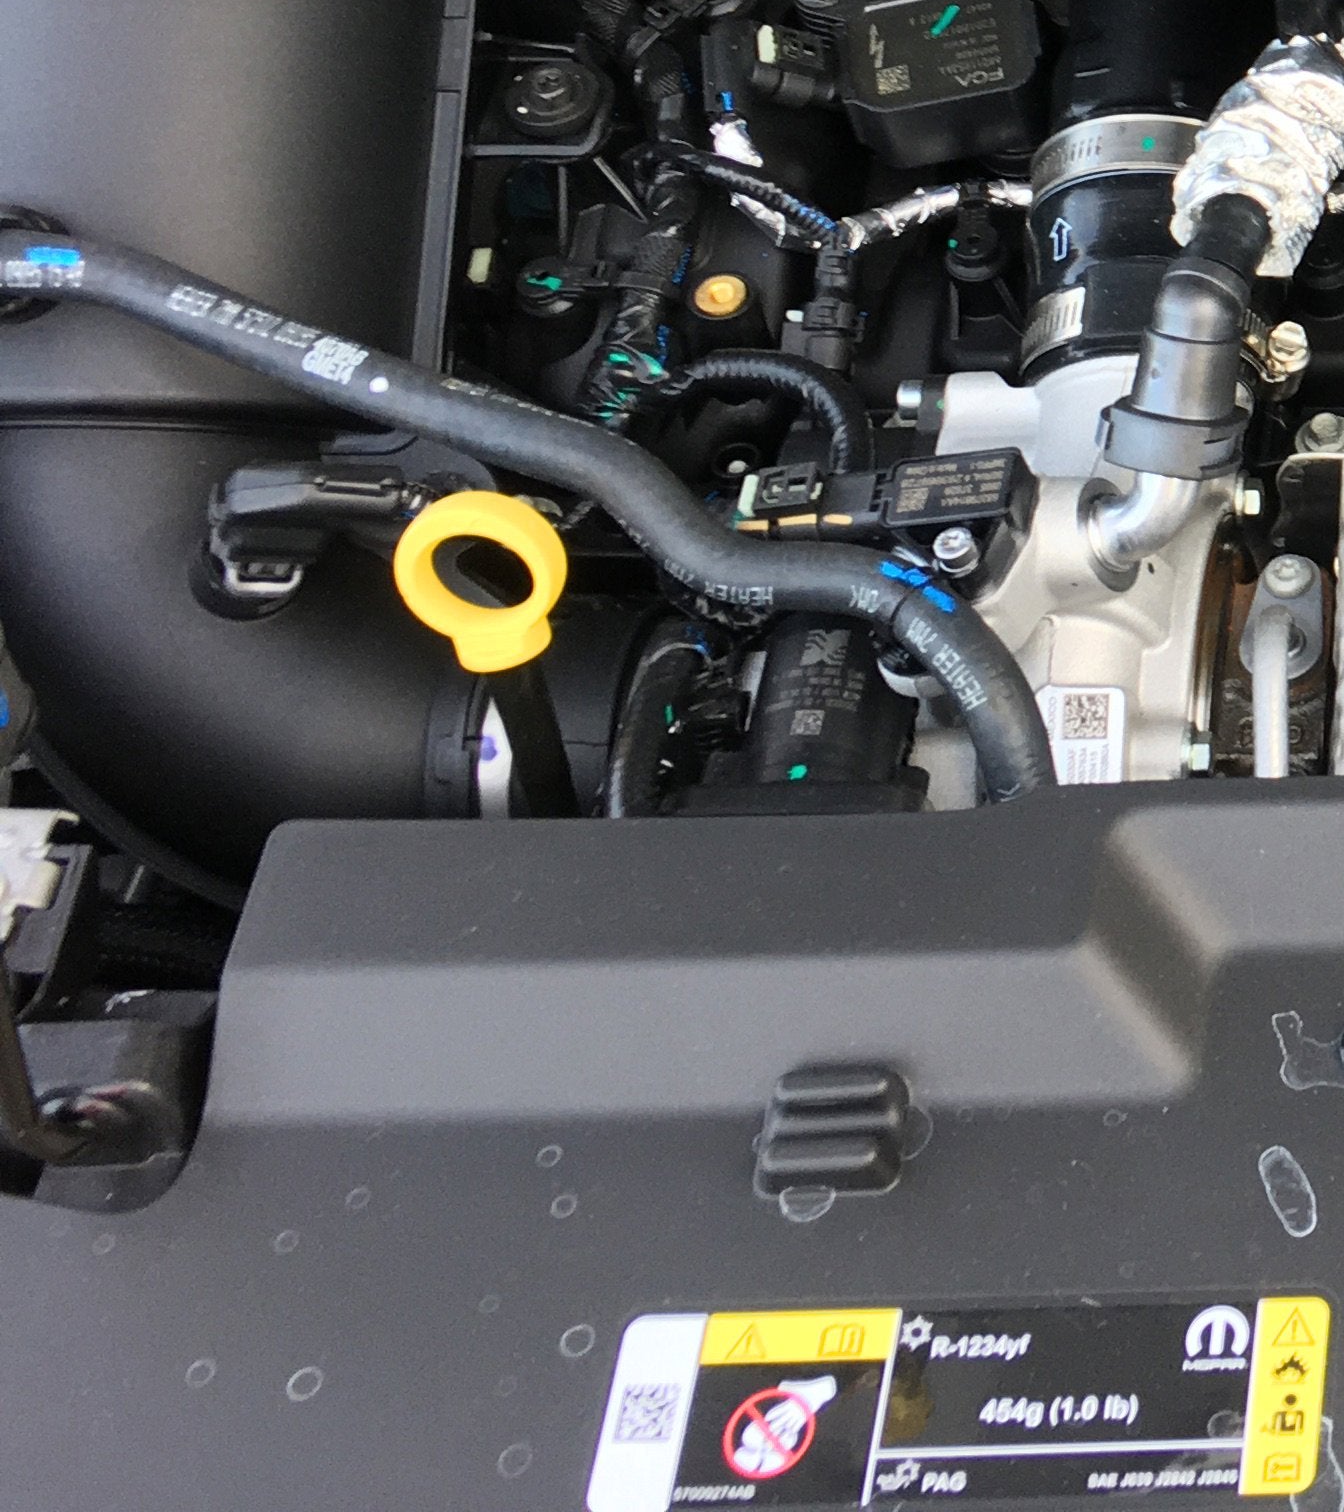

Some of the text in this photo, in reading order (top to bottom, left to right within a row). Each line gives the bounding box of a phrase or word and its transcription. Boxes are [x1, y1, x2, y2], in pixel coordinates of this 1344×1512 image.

[931, 642, 988, 712] HEATER
[930, 1333, 1032, 1361] R-1234yf
[979, 1393, 1139, 1428] 454g (1.0 lb)
[921, 1471, 967, 1493] PAG
